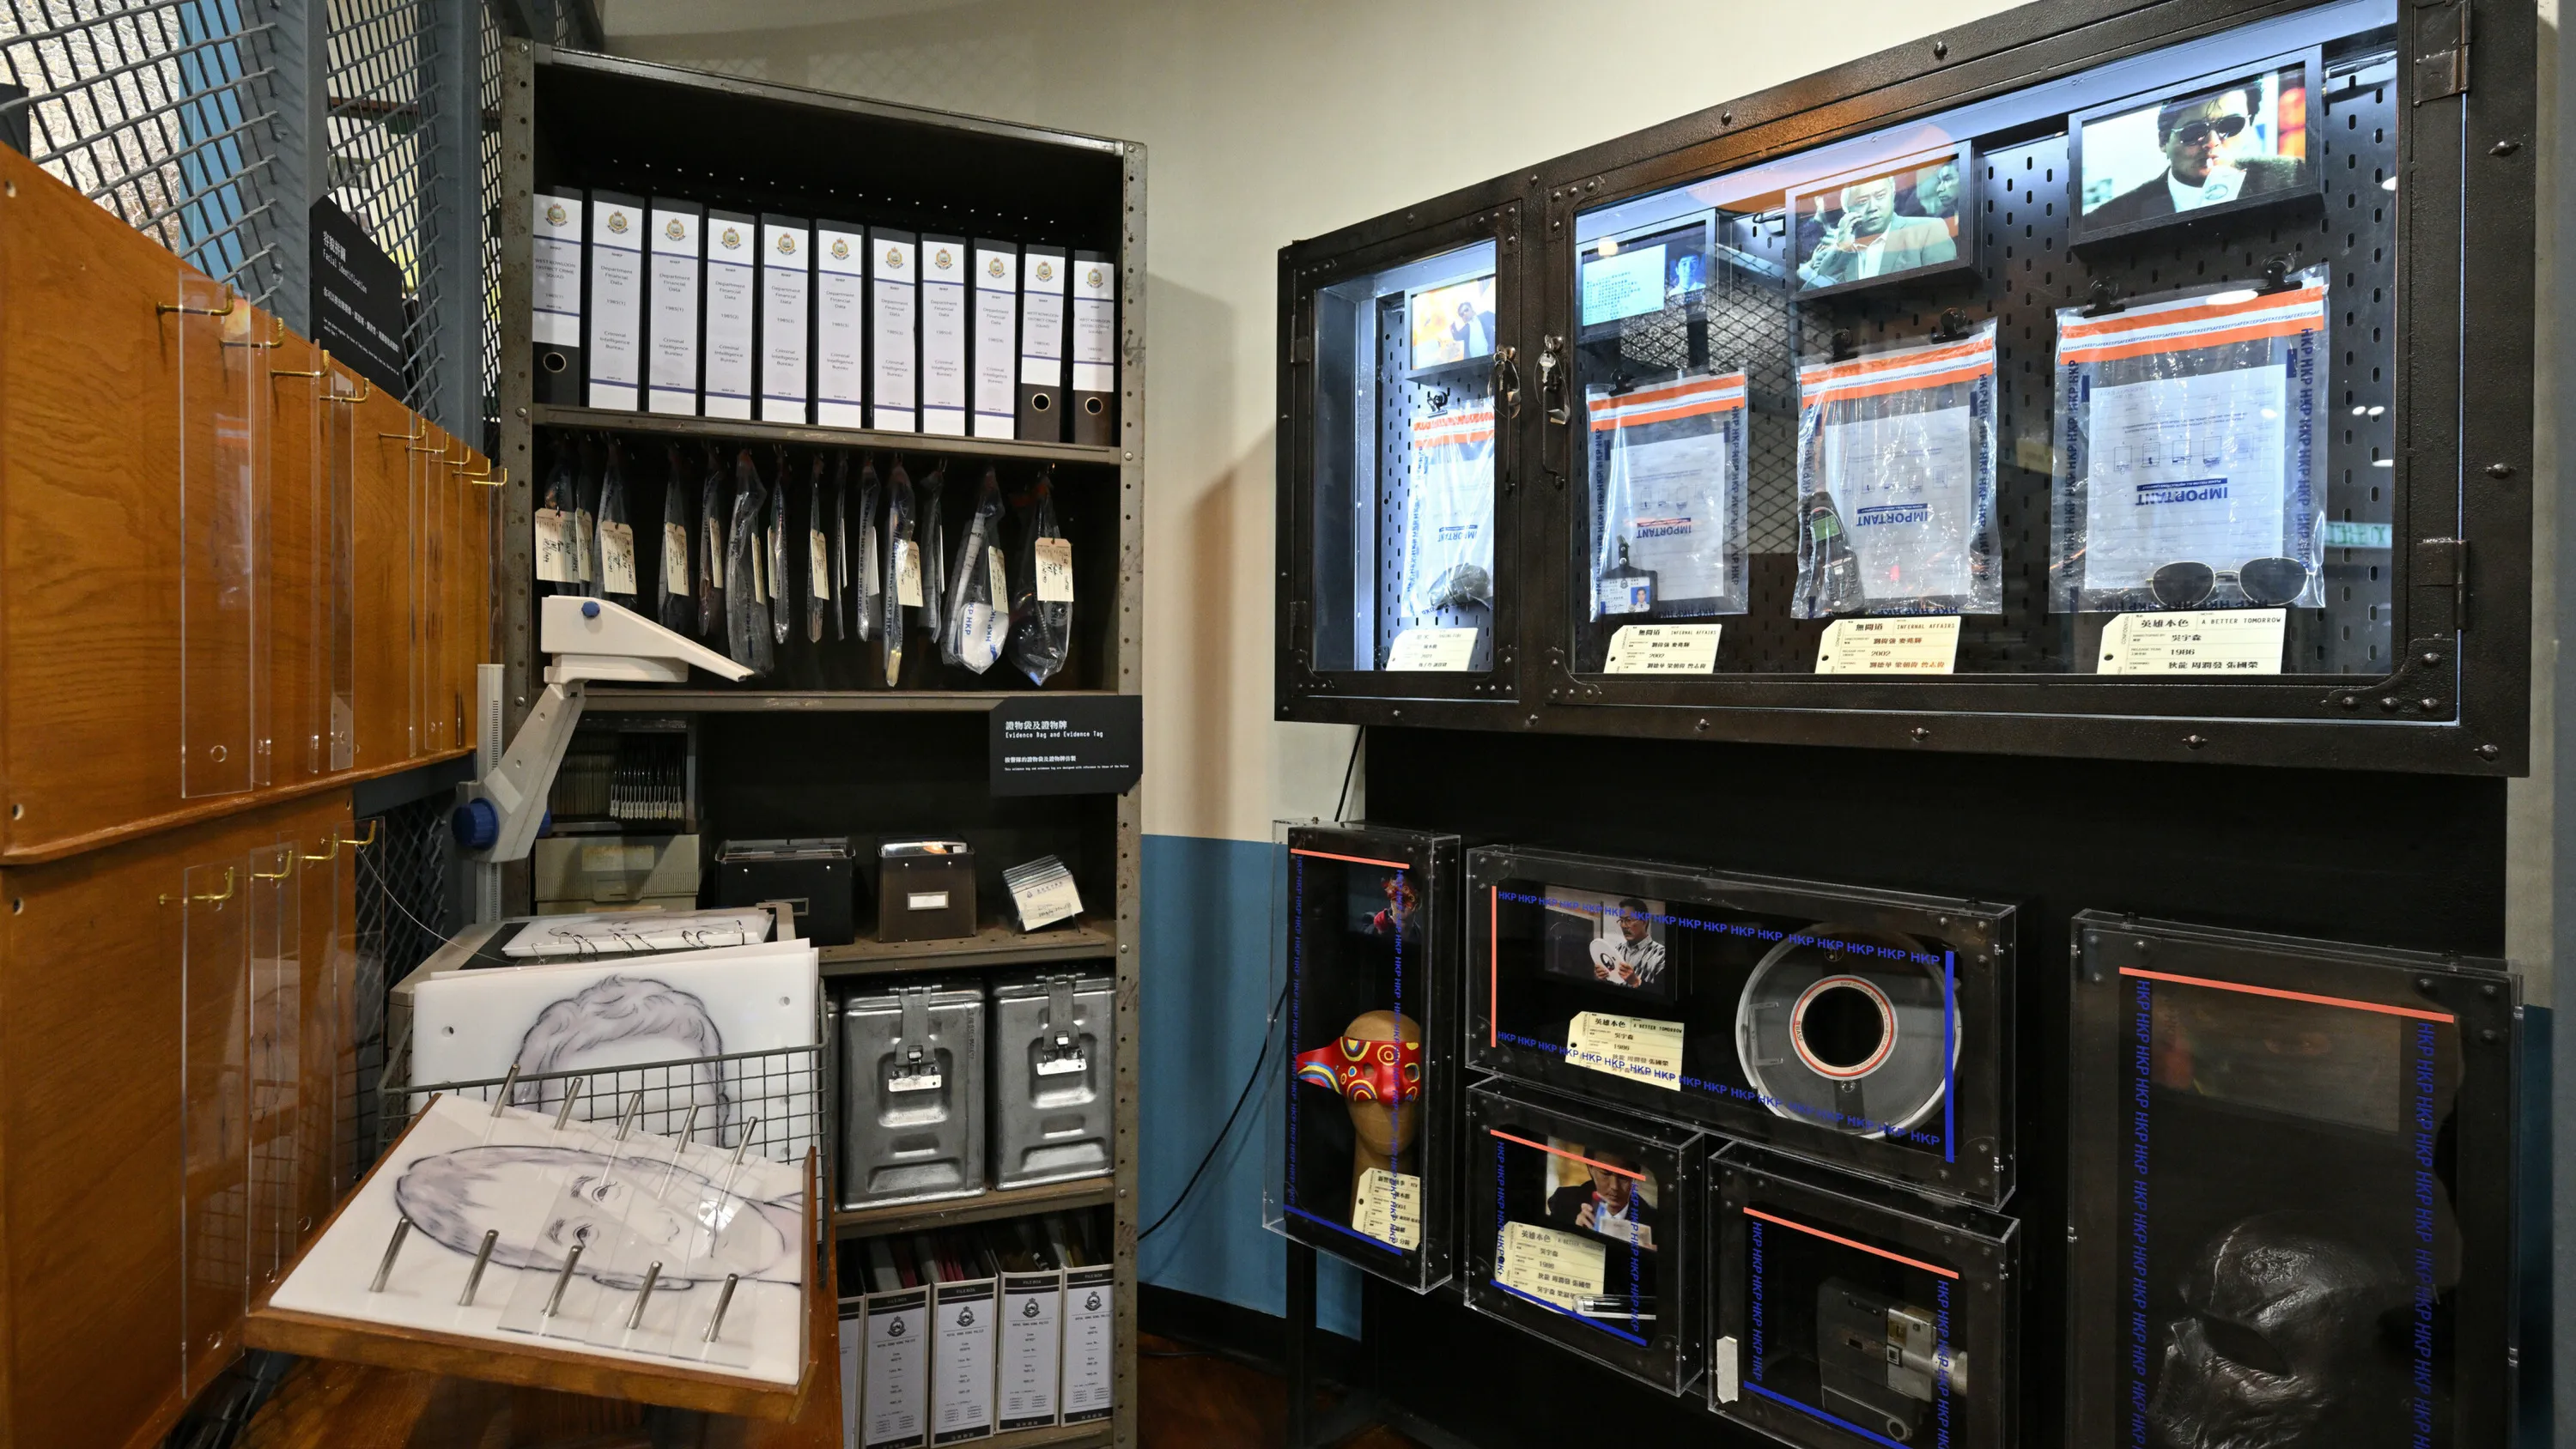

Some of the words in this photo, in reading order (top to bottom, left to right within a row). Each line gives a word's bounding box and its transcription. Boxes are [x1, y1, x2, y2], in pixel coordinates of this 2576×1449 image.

[323, 248, 337, 269] Facial
[338, 262, 368, 294] Identification
[600, 265, 633, 275] Department
[605, 272, 629, 281] Financial
[659, 272, 690, 282] Department
[714, 280, 745, 289] Department
[599, 336, 631, 346] Intelligence
[604, 330, 627, 338] Criminal
[2301, 328, 2314, 354] HKP
[2300, 358, 2312, 385] HKP
[1978, 373, 1988, 396] HKP
[1978, 398, 1988, 421] HKP
[2300, 390, 2312, 415] HKP
[1731, 405, 1740, 426] HKP
[2299, 420, 2312, 445] HKP
[2299, 449, 2312, 476] HKP
[2136, 487, 2228, 506] IMPORTANT
[2299, 480, 2311, 506] HKP
[1856, 511, 1929, 527] IMPORTANT
[2064, 500, 2075, 524] HKP
[1637, 525, 1692, 539] IMPORTANT
[2063, 529, 2075, 551] HKP
[2061, 555, 2074, 578] HKP
[964, 617, 973, 635] HKP
[2141, 619, 2190, 628] 英雄本色
[2191, 661, 2223, 670] 周潤發
[2226, 661, 2259, 670] 張國榮
[1005, 720, 1067, 731] 證物袋及證物牌
[1093, 731, 1103, 739] Tag
[1498, 891, 1517, 900] HKP
[1517, 894, 1538, 904] HKP
[1538, 896, 1558, 907] HKP
[1559, 900, 1579, 911] HKP
[1583, 903, 1603, 914] HKP
[1604, 906, 1625, 918] HKP
[1630, 910, 1653, 922] HKP
[1653, 913, 1677, 925] HKP
[1678, 917, 1702, 930] HKP
[1703, 921, 1728, 933] HKP
[1730, 925, 1756, 937] HKP
[1757, 929, 1783, 942] HKP
[1788, 933, 1815, 946] HKP
[1816, 937, 1844, 951] HKP
[1846, 942, 1874, 955] HKP
[1877, 947, 1906, 961] HKP
[1910, 951, 1941, 966] HKP
[2136, 979, 2151, 1011] HKP
[1595, 1018, 1626, 1028] 英雄本色
[1795, 1026, 1804, 1042] BASF
[2136, 1012, 2150, 1044] HKP
[2417, 1022, 2434, 1057] HKP
[2136, 1045, 2150, 1076] HKP
[2416, 1058, 2433, 1094] HKP
[2136, 1077, 2149, 1108] HKP
[2416, 1096, 2433, 1131] HKP
[1497, 1141, 1505, 1163] HKP
[1497, 1164, 1505, 1186] HKP
[1497, 1187, 1505, 1210] HKP
[1521, 1229, 1552, 1243] 英雄本色
[1753, 1222, 1763, 1247] HKP
[1753, 1247, 1763, 1274] HKP
[1753, 1274, 1763, 1300] HKP
[1937, 1280, 1949, 1309] HKP
[1753, 1300, 1763, 1327] HKP
[1938, 1309, 1949, 1338] HKP
[1753, 1329, 1763, 1355] HKP
[1937, 1338, 1948, 1367] HKP
[1753, 1355, 1763, 1381] HKP
